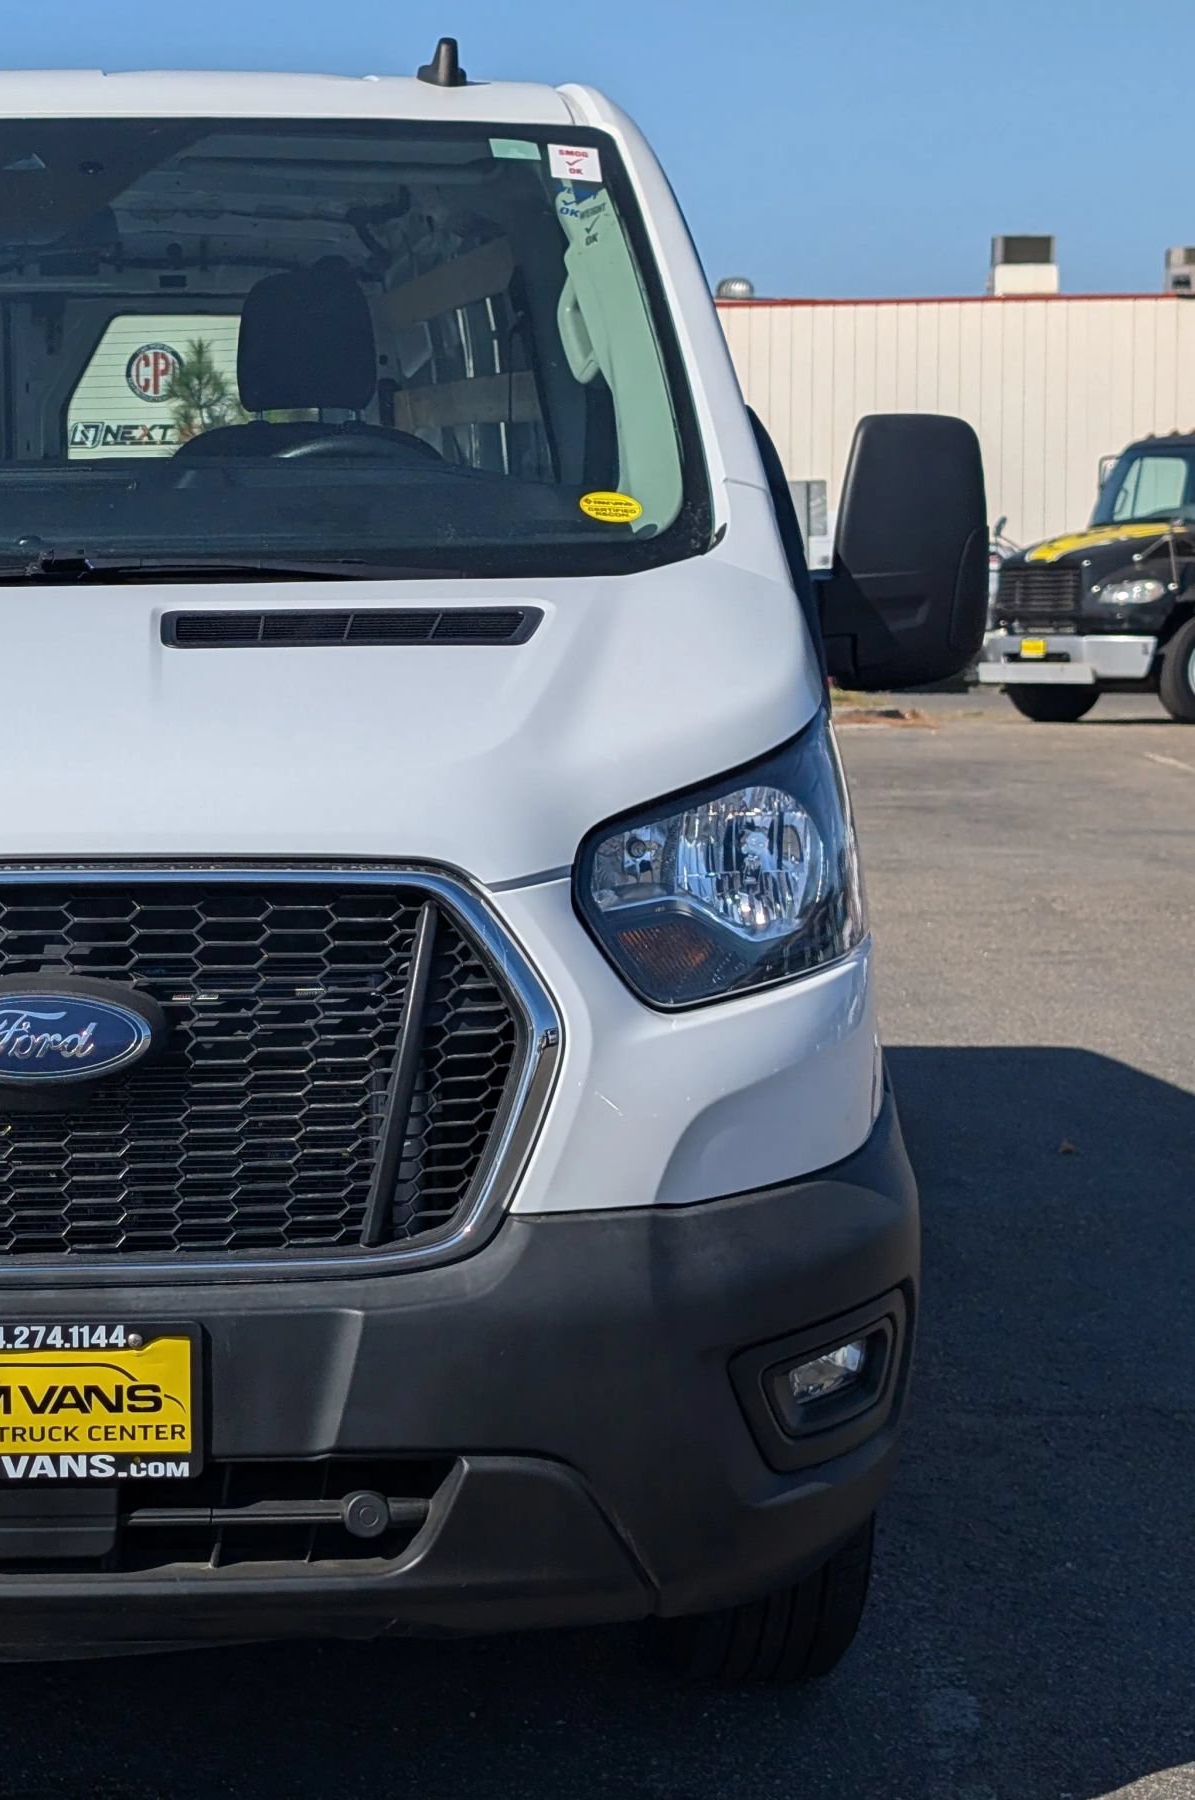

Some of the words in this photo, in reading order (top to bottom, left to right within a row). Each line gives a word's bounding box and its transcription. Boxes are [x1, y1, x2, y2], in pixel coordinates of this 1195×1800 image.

[558, 149, 589, 158] SMOG
[559, 206, 580, 218] OK
[588, 506, 636, 514] CERTIFIED
[18, 1384, 163, 1414] VANS
[88, 1424, 186, 1441] CENTER
